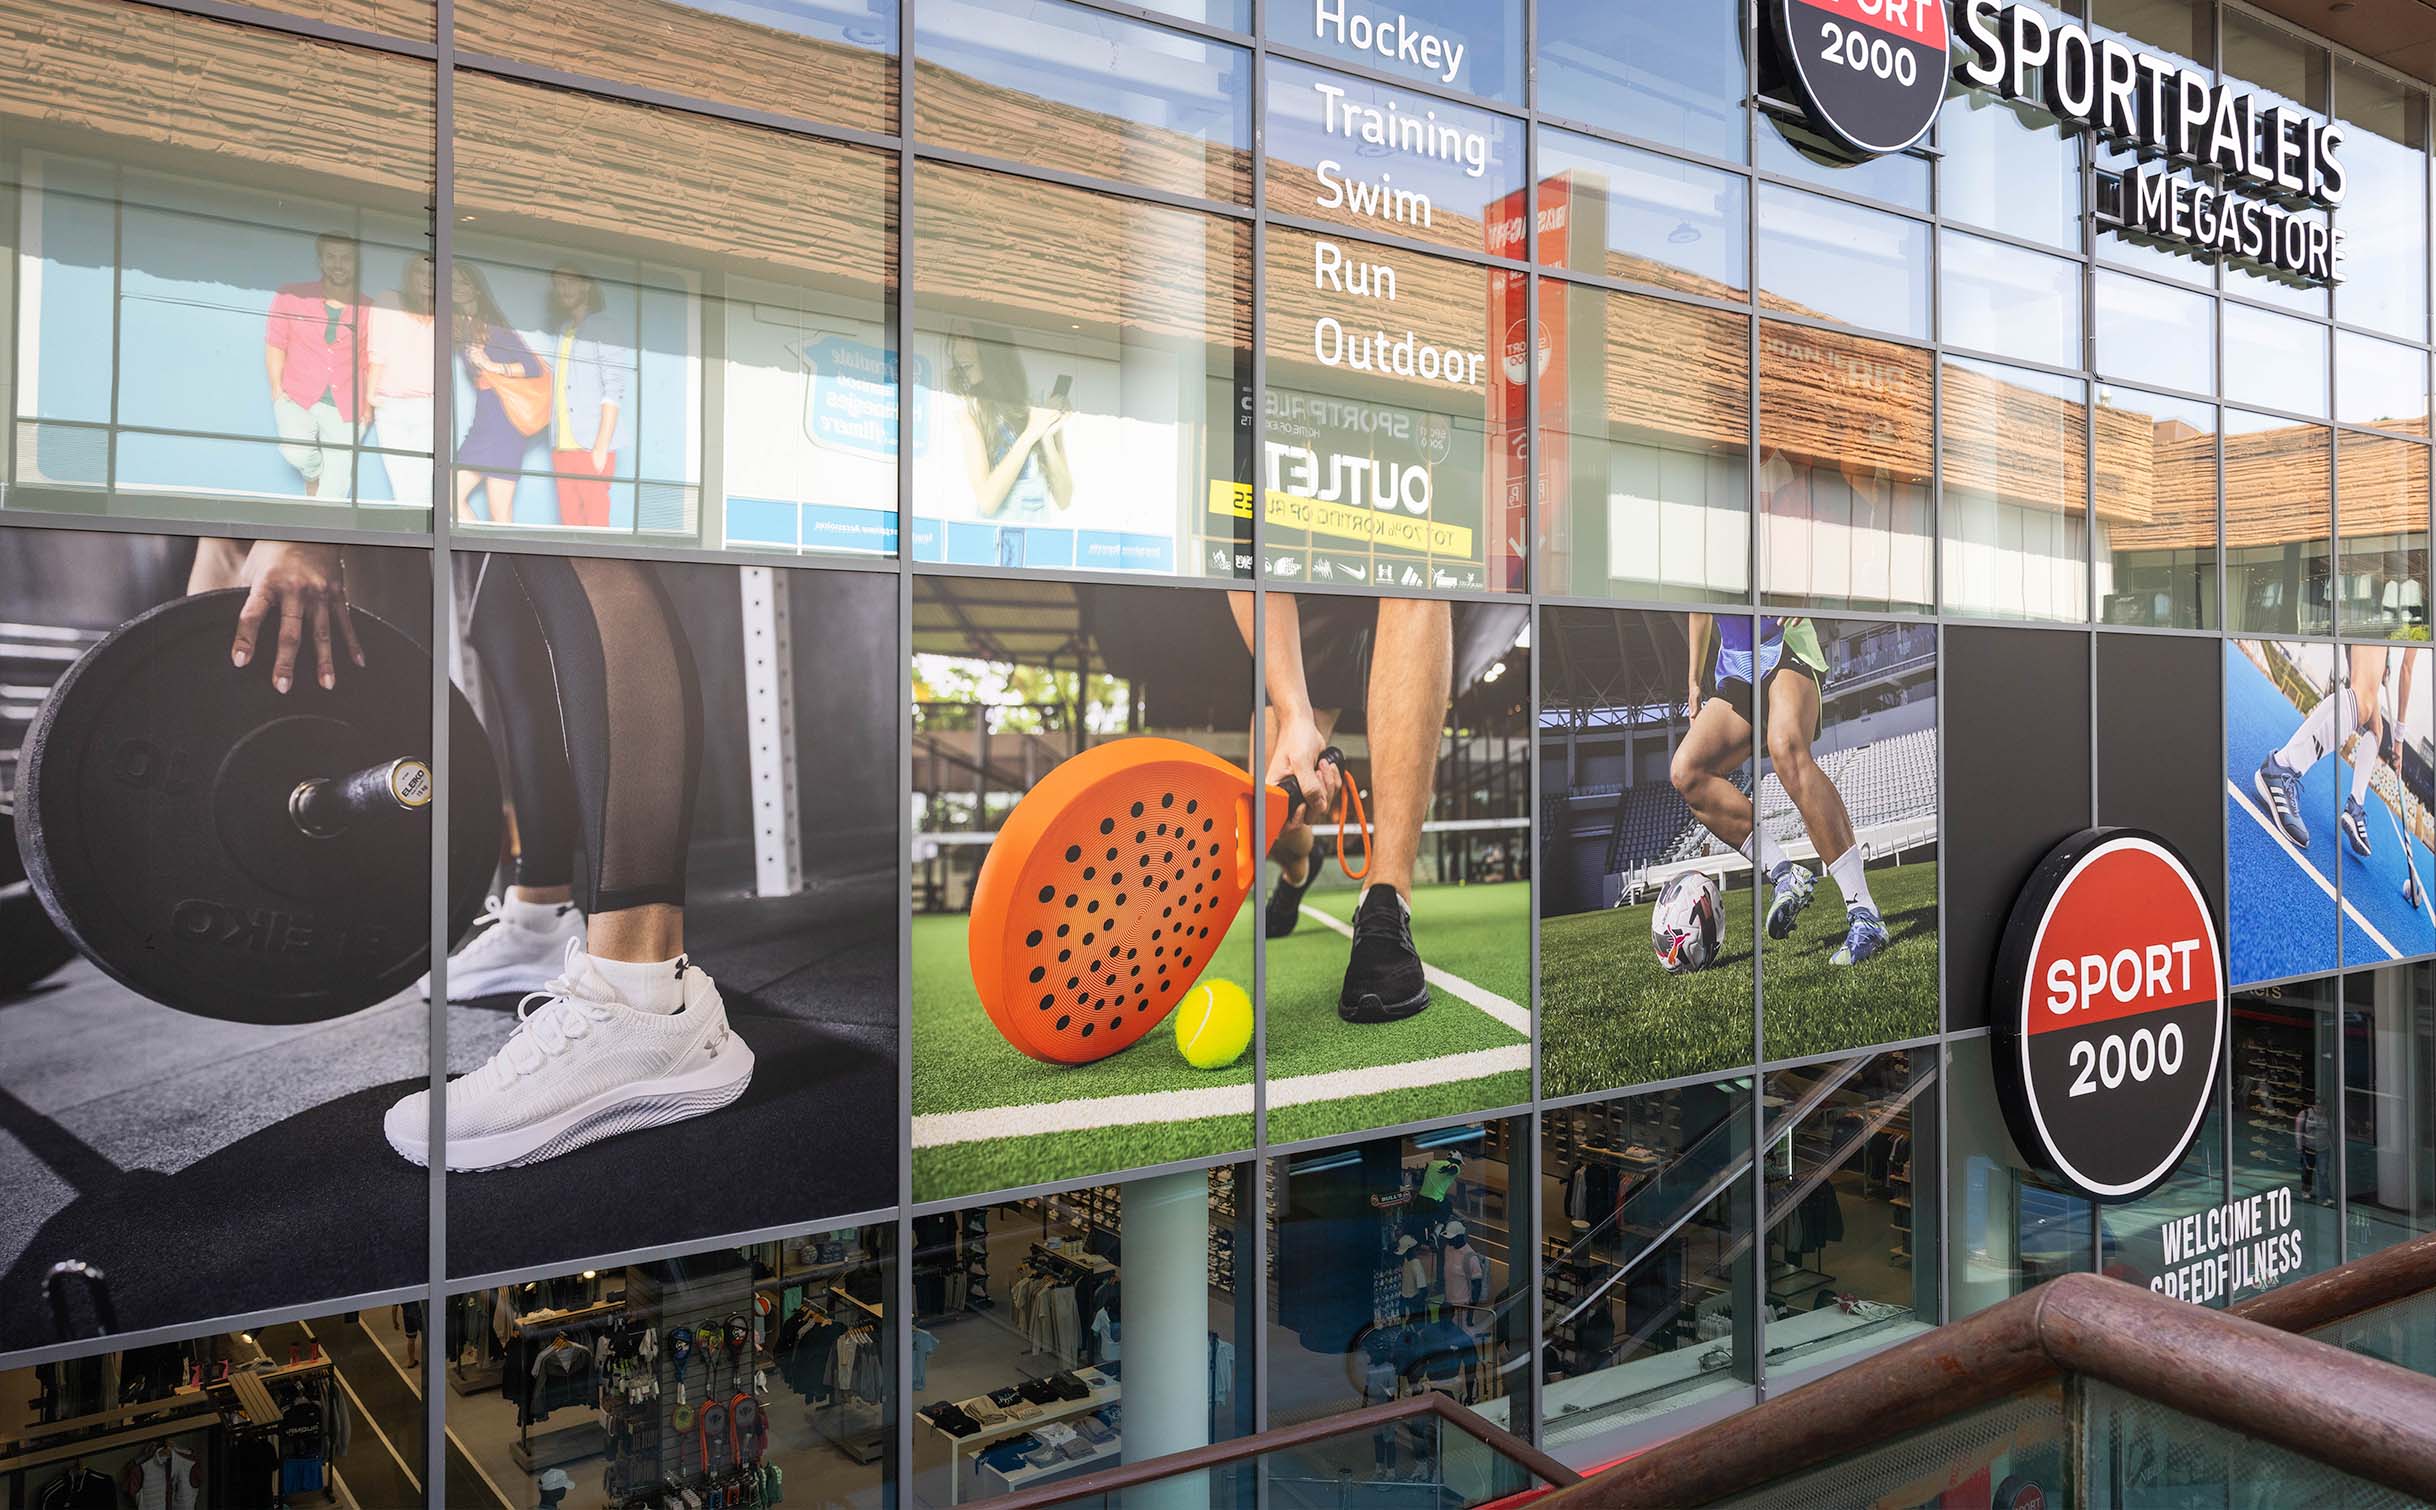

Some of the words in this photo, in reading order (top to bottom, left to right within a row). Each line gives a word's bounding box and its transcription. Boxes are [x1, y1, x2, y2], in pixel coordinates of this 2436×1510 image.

[1315, 0, 1464, 83] Hockey
[1820, 22, 1917, 87] 2000
[1314, 82, 1486, 178] Training
[1966, 0, 2347, 204] SPORTPALEIS
[1316, 159, 1431, 228] Swim
[2136, 165, 2348, 283] MEGASTORE
[1315, 241, 1396, 301] Run
[1315, 317, 1486, 385] Outdoor
[401, 769, 424, 797] ELEIKO
[2047, 938, 2200, 1015] SPORT
[2069, 1022, 2184, 1098] 2000
[2161, 1194, 2262, 1266] WELCOME
[2266, 1186, 2291, 1231] TO
